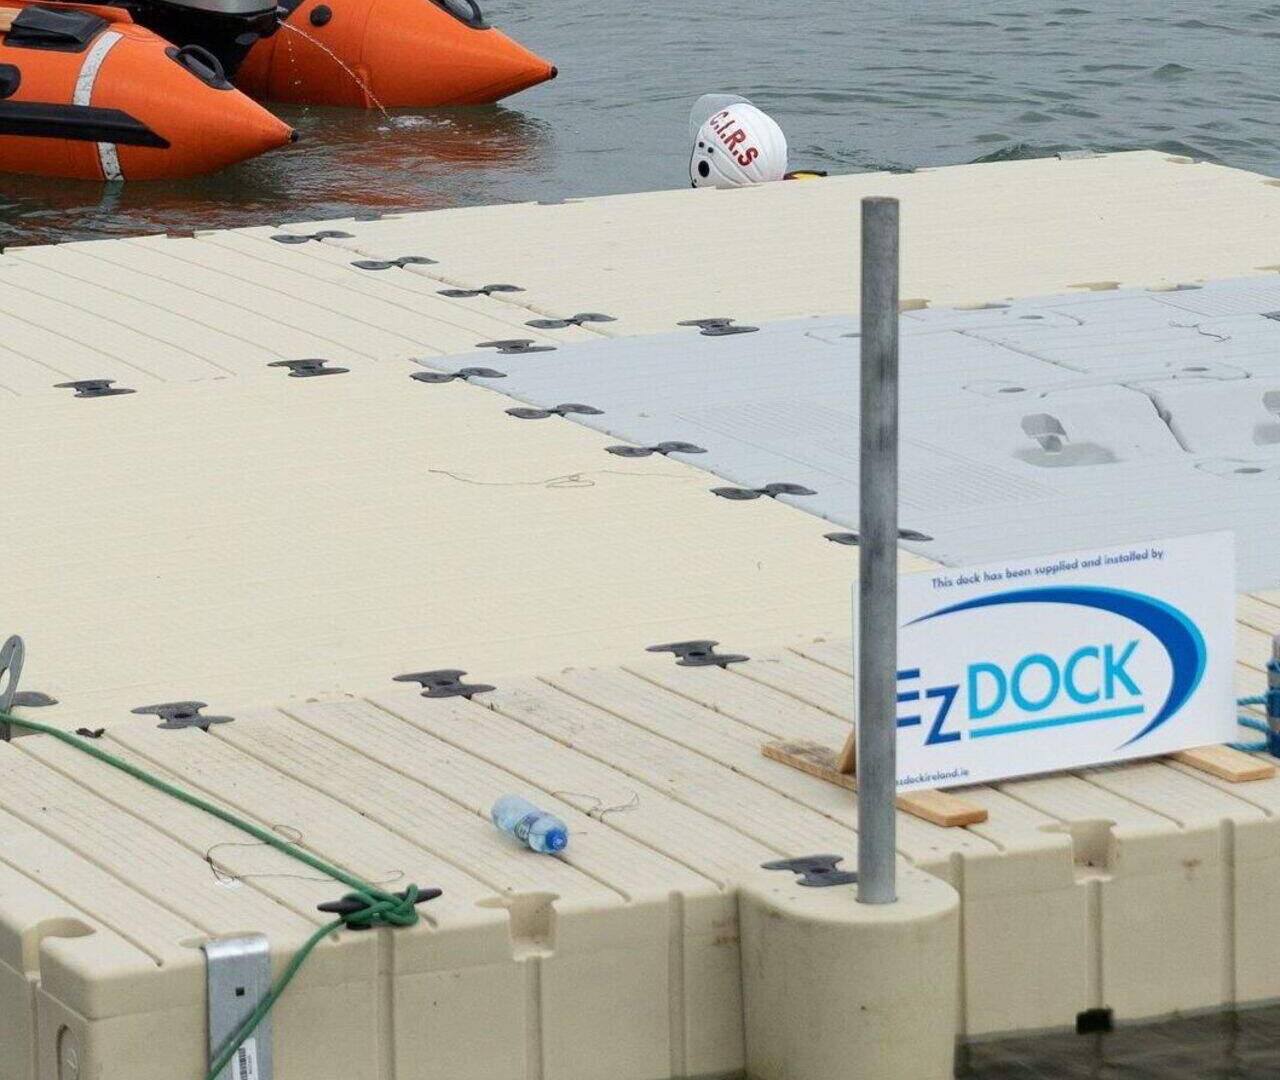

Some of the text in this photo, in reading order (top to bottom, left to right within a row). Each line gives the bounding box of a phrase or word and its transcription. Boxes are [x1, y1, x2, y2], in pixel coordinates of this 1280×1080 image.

[932, 548, 1163, 588] This dock has been supplied and installed by
